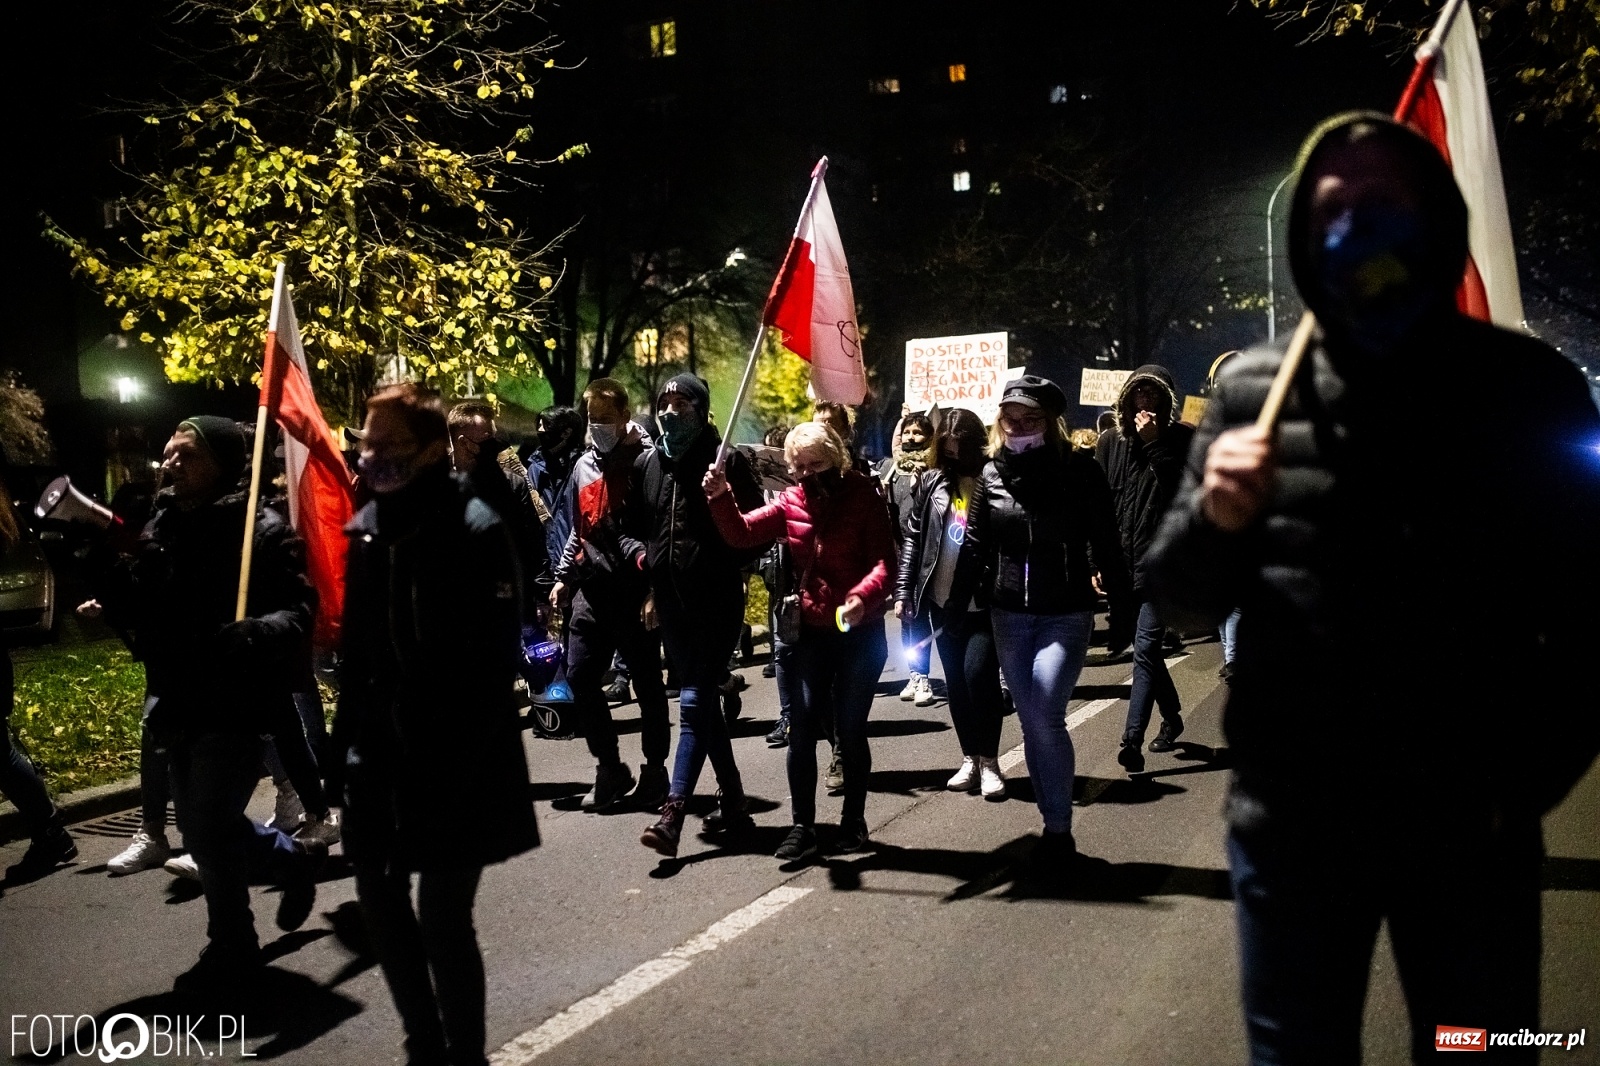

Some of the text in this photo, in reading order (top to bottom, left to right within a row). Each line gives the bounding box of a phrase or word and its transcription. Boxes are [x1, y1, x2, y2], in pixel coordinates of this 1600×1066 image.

[914, 341, 1003, 358] DOSTĘP DO
[912, 355, 1005, 374] BEZPIECZNEJ
[1084, 371, 1124, 382] JAREK TO
